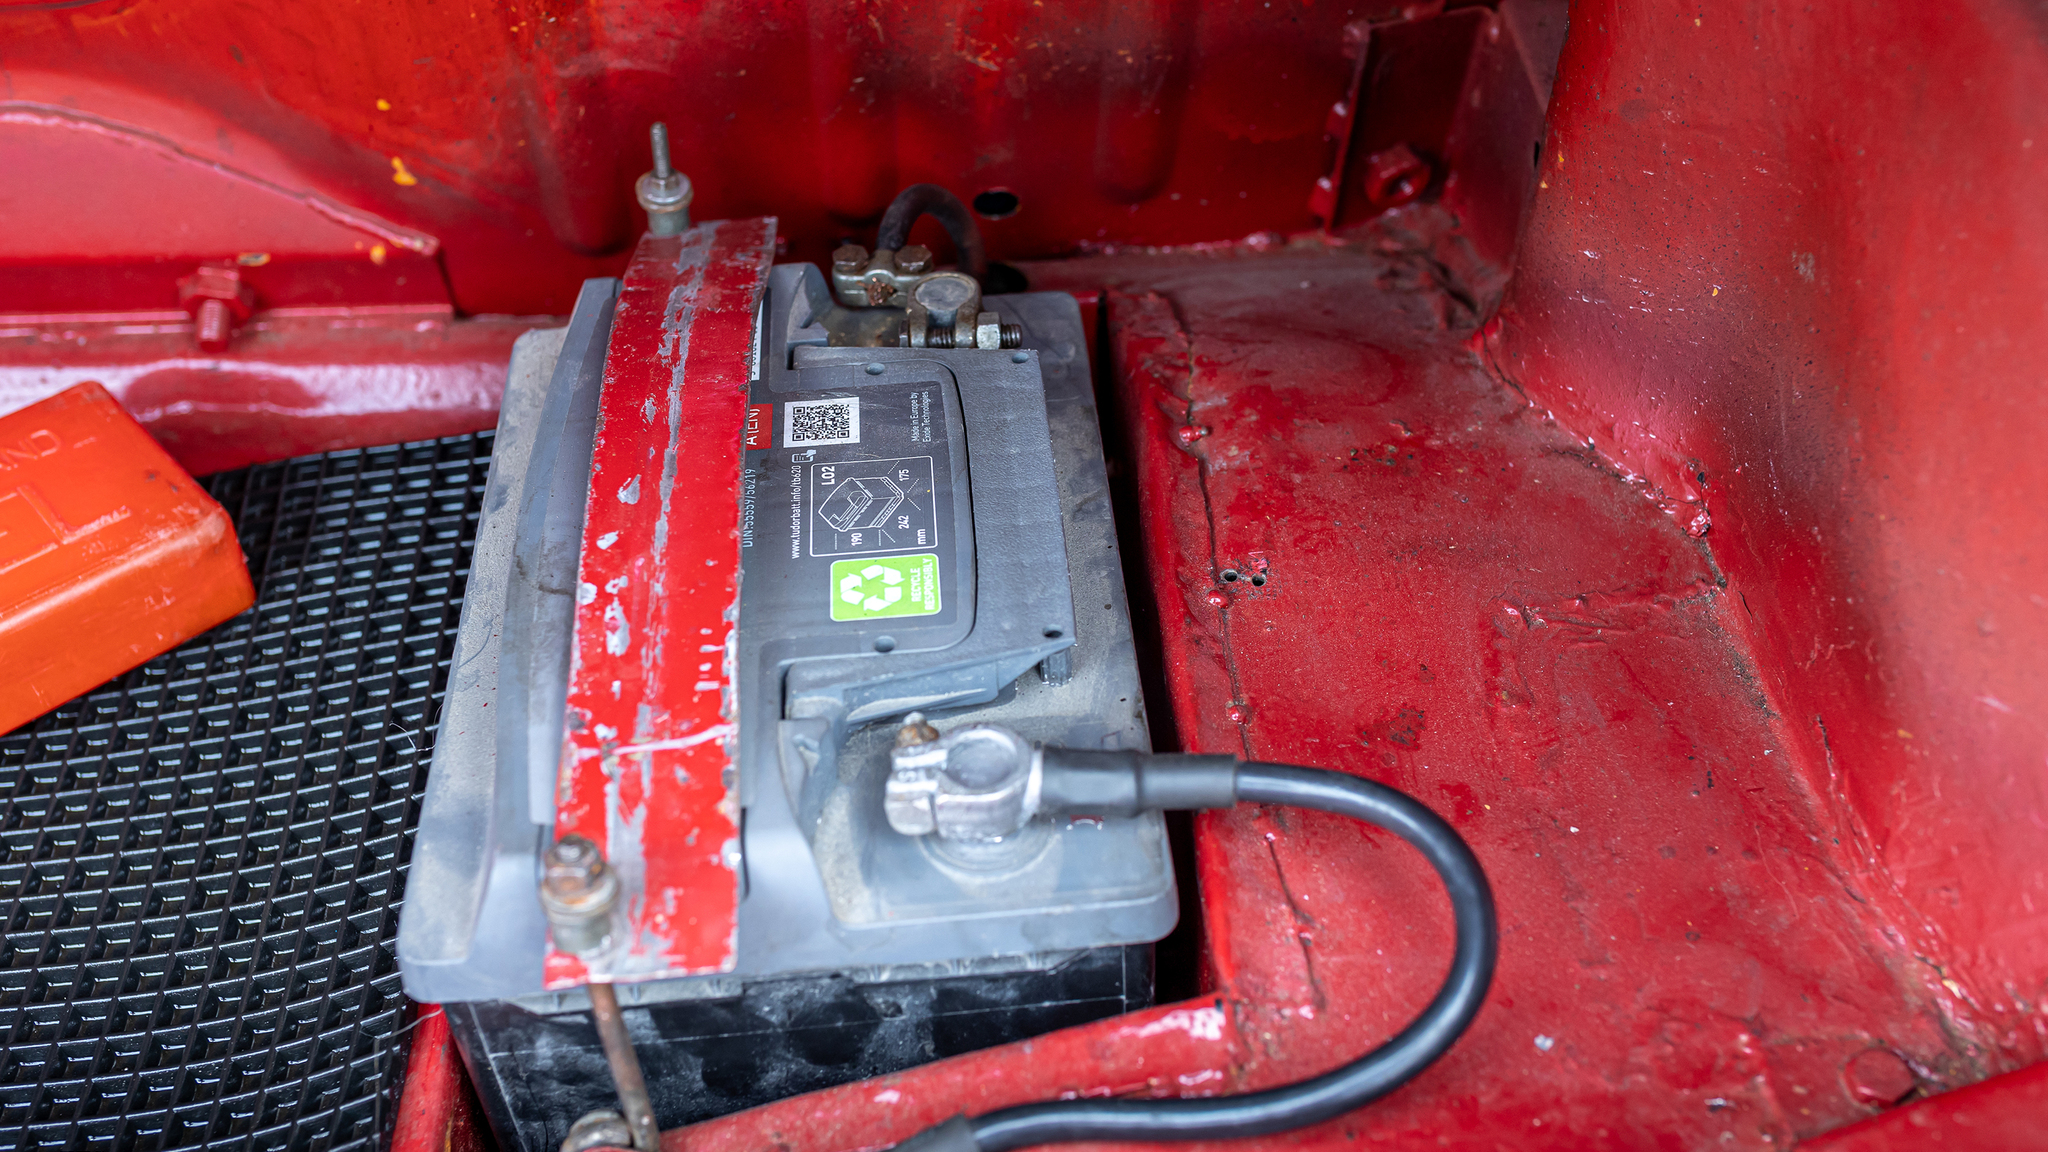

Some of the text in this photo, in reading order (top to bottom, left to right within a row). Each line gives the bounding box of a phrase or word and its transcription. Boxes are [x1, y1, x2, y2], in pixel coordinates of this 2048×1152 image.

[910, 400, 919, 419] Europe
[921, 391, 931, 442] Exide Technologies
[910, 426, 919, 442] Made
[899, 469, 909, 482] 175
[790, 465, 802, 559] www.tudorbatt.info/tb620
[898, 515, 909, 530] 242
[851, 533, 862, 546] 190
[917, 529, 926, 545] mm
[910, 567, 921, 602] RECYCLE
[922, 558, 935, 610] RESPONSIBLY
